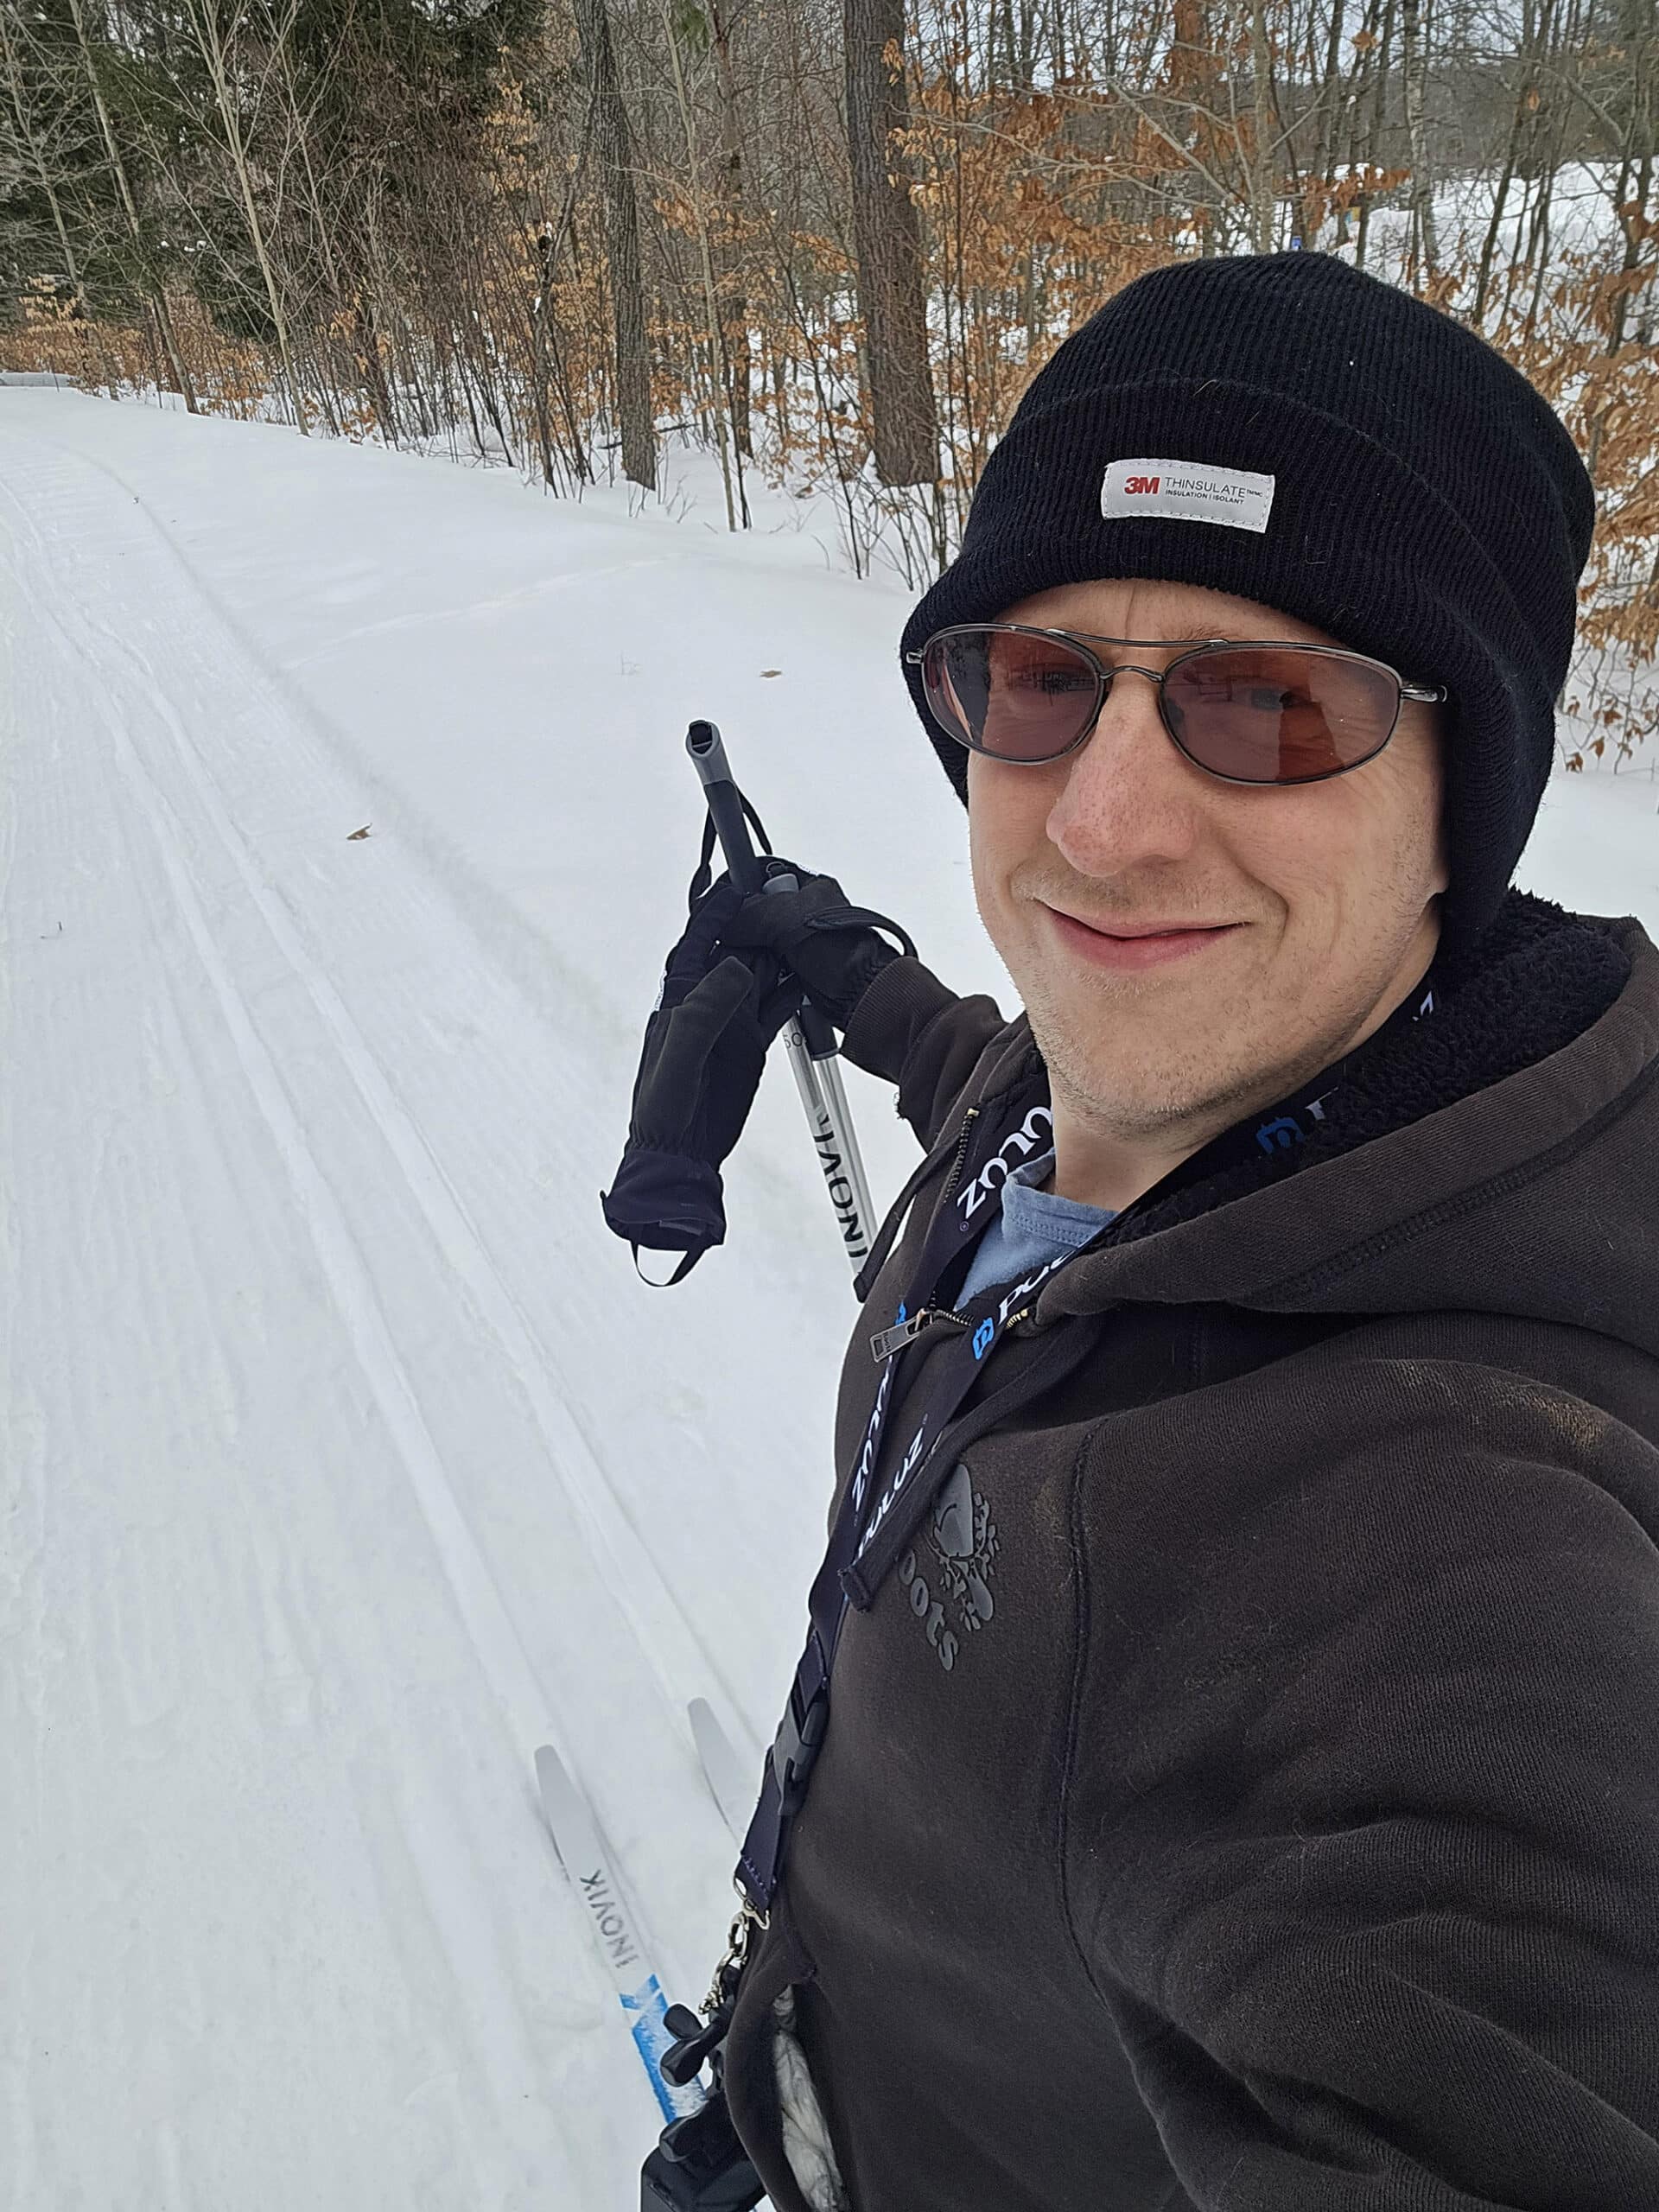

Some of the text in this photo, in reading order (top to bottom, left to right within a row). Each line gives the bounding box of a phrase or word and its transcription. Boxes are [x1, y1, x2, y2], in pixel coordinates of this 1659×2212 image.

[1124, 476, 1160, 494] 3M
[1166, 476, 1246, 499] THINSULATE
[1166, 489, 1245, 505] INSULATION ISOLANT
[579, 1868, 640, 1969] INOVIK
